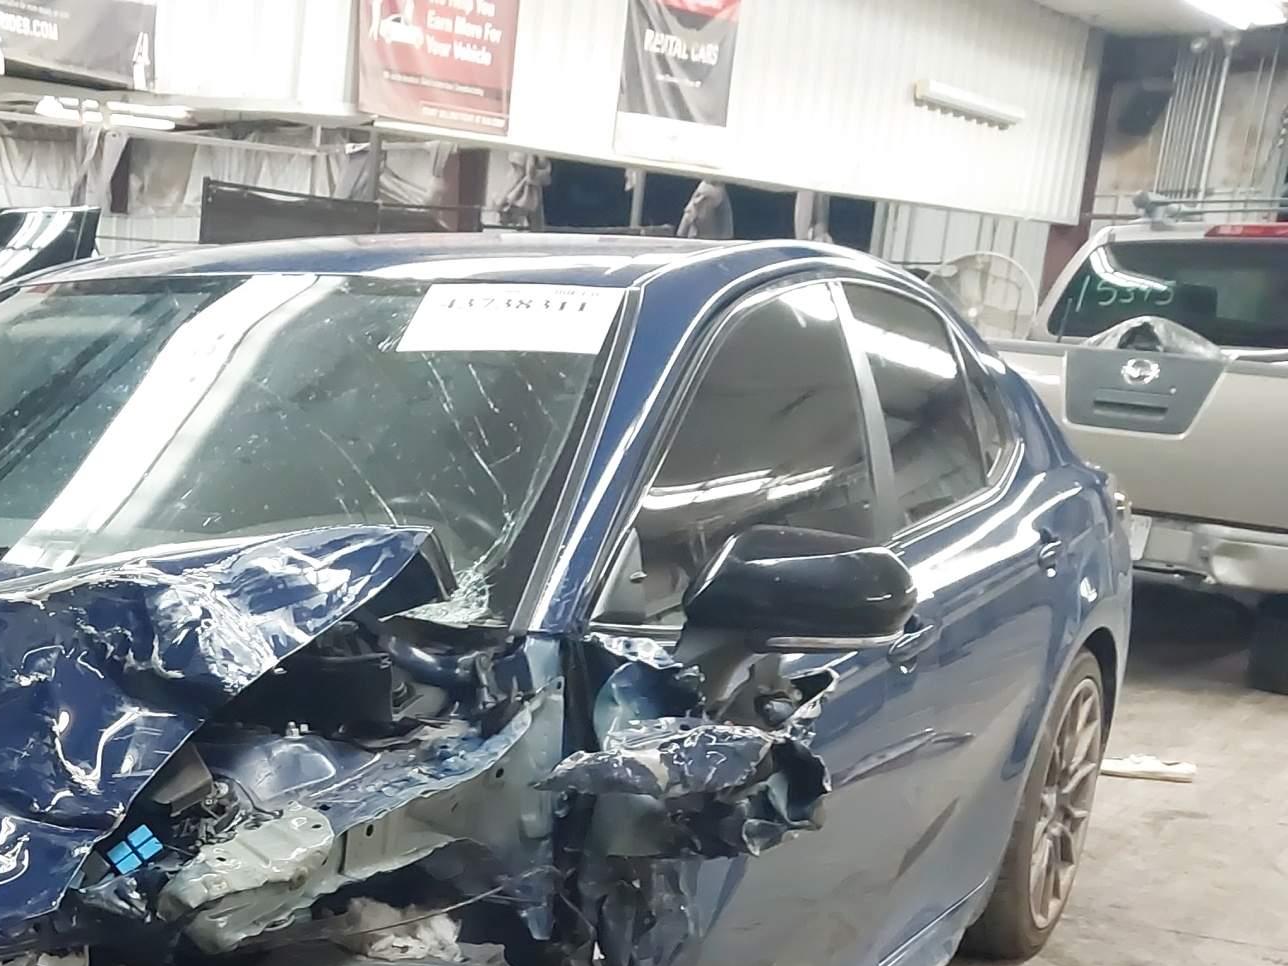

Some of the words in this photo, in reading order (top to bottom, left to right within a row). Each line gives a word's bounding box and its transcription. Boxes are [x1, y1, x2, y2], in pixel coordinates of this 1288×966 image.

[483, 22, 502, 44] For
[453, 40, 492, 66] Vehicle
[644, 28, 688, 60] RENTAL
[690, 42, 719, 66] CARS
